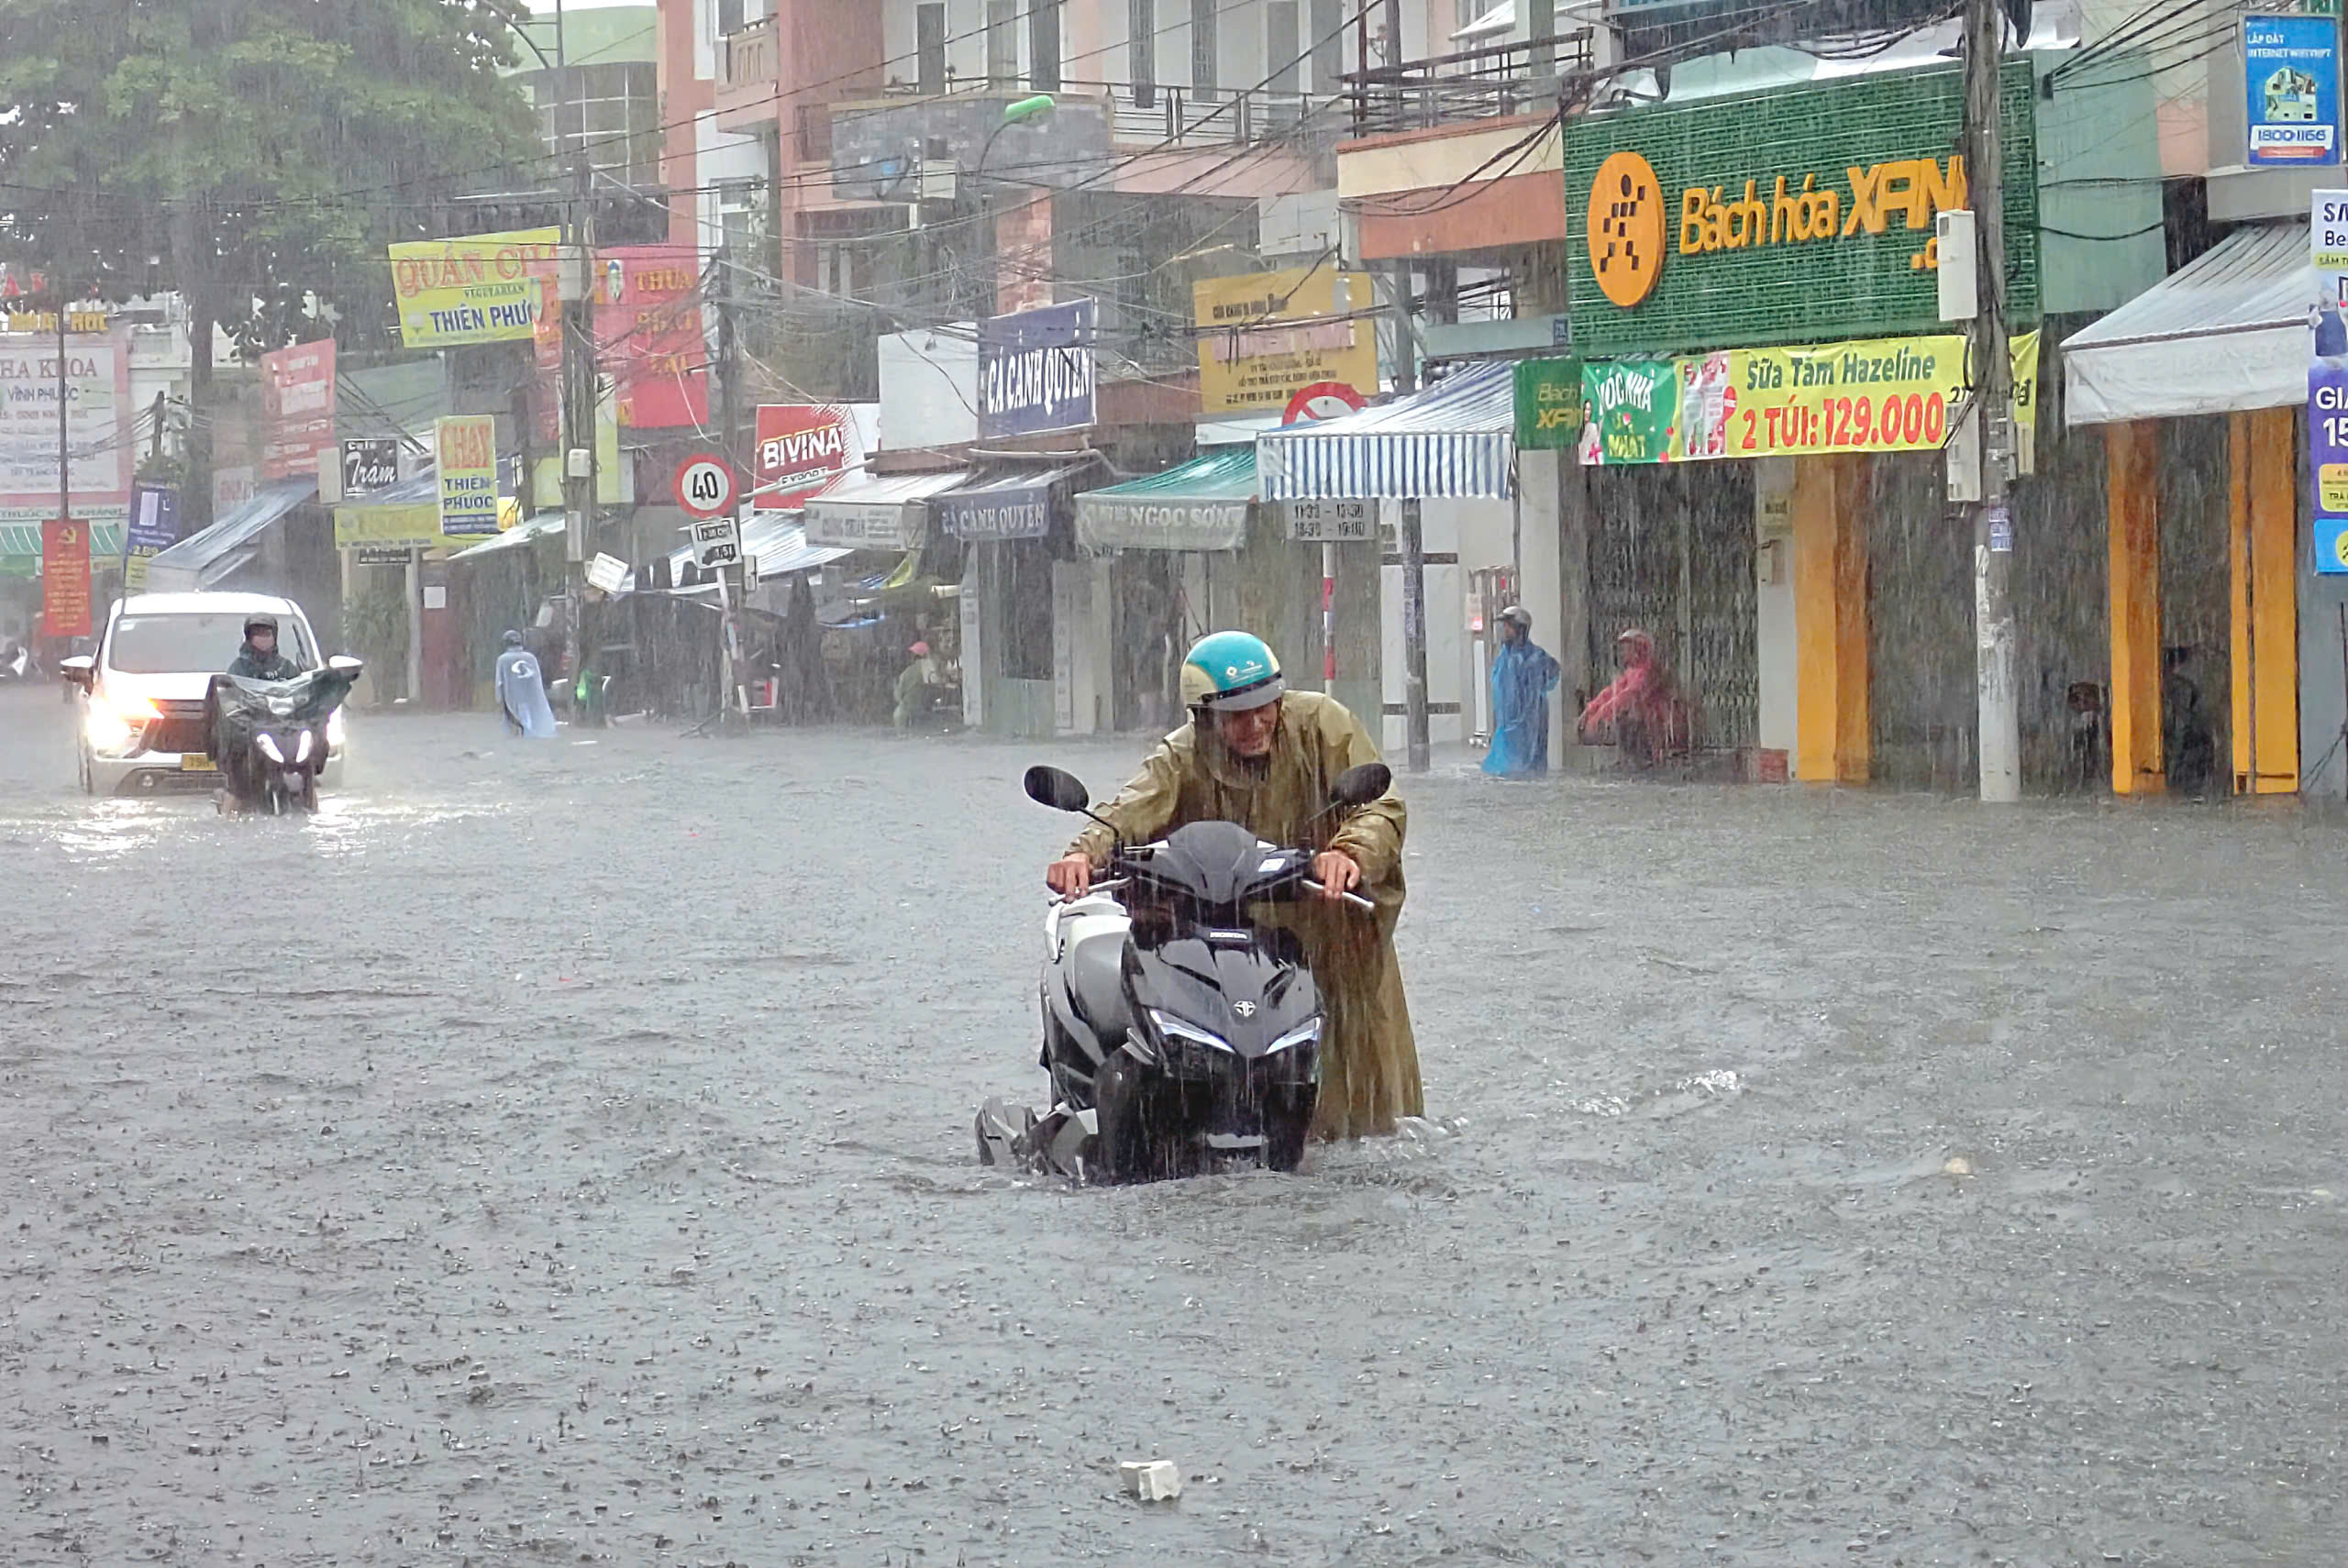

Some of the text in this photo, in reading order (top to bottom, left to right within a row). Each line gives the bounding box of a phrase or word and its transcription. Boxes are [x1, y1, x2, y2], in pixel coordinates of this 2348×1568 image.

[1679, 180, 1767, 254] Bách
[1771, 173, 1839, 243] hóa
[2325, 229, 2348, 246] Be
[1842, 346, 1936, 384] Hazeline
[440, 425, 491, 469] CHAY
[763, 427, 843, 469] BIVINA
[1742, 409, 1756, 449] 2
[346, 451, 397, 486] Trâm
[444, 474, 492, 491] THIÊN
[692, 471, 718, 501] 40
